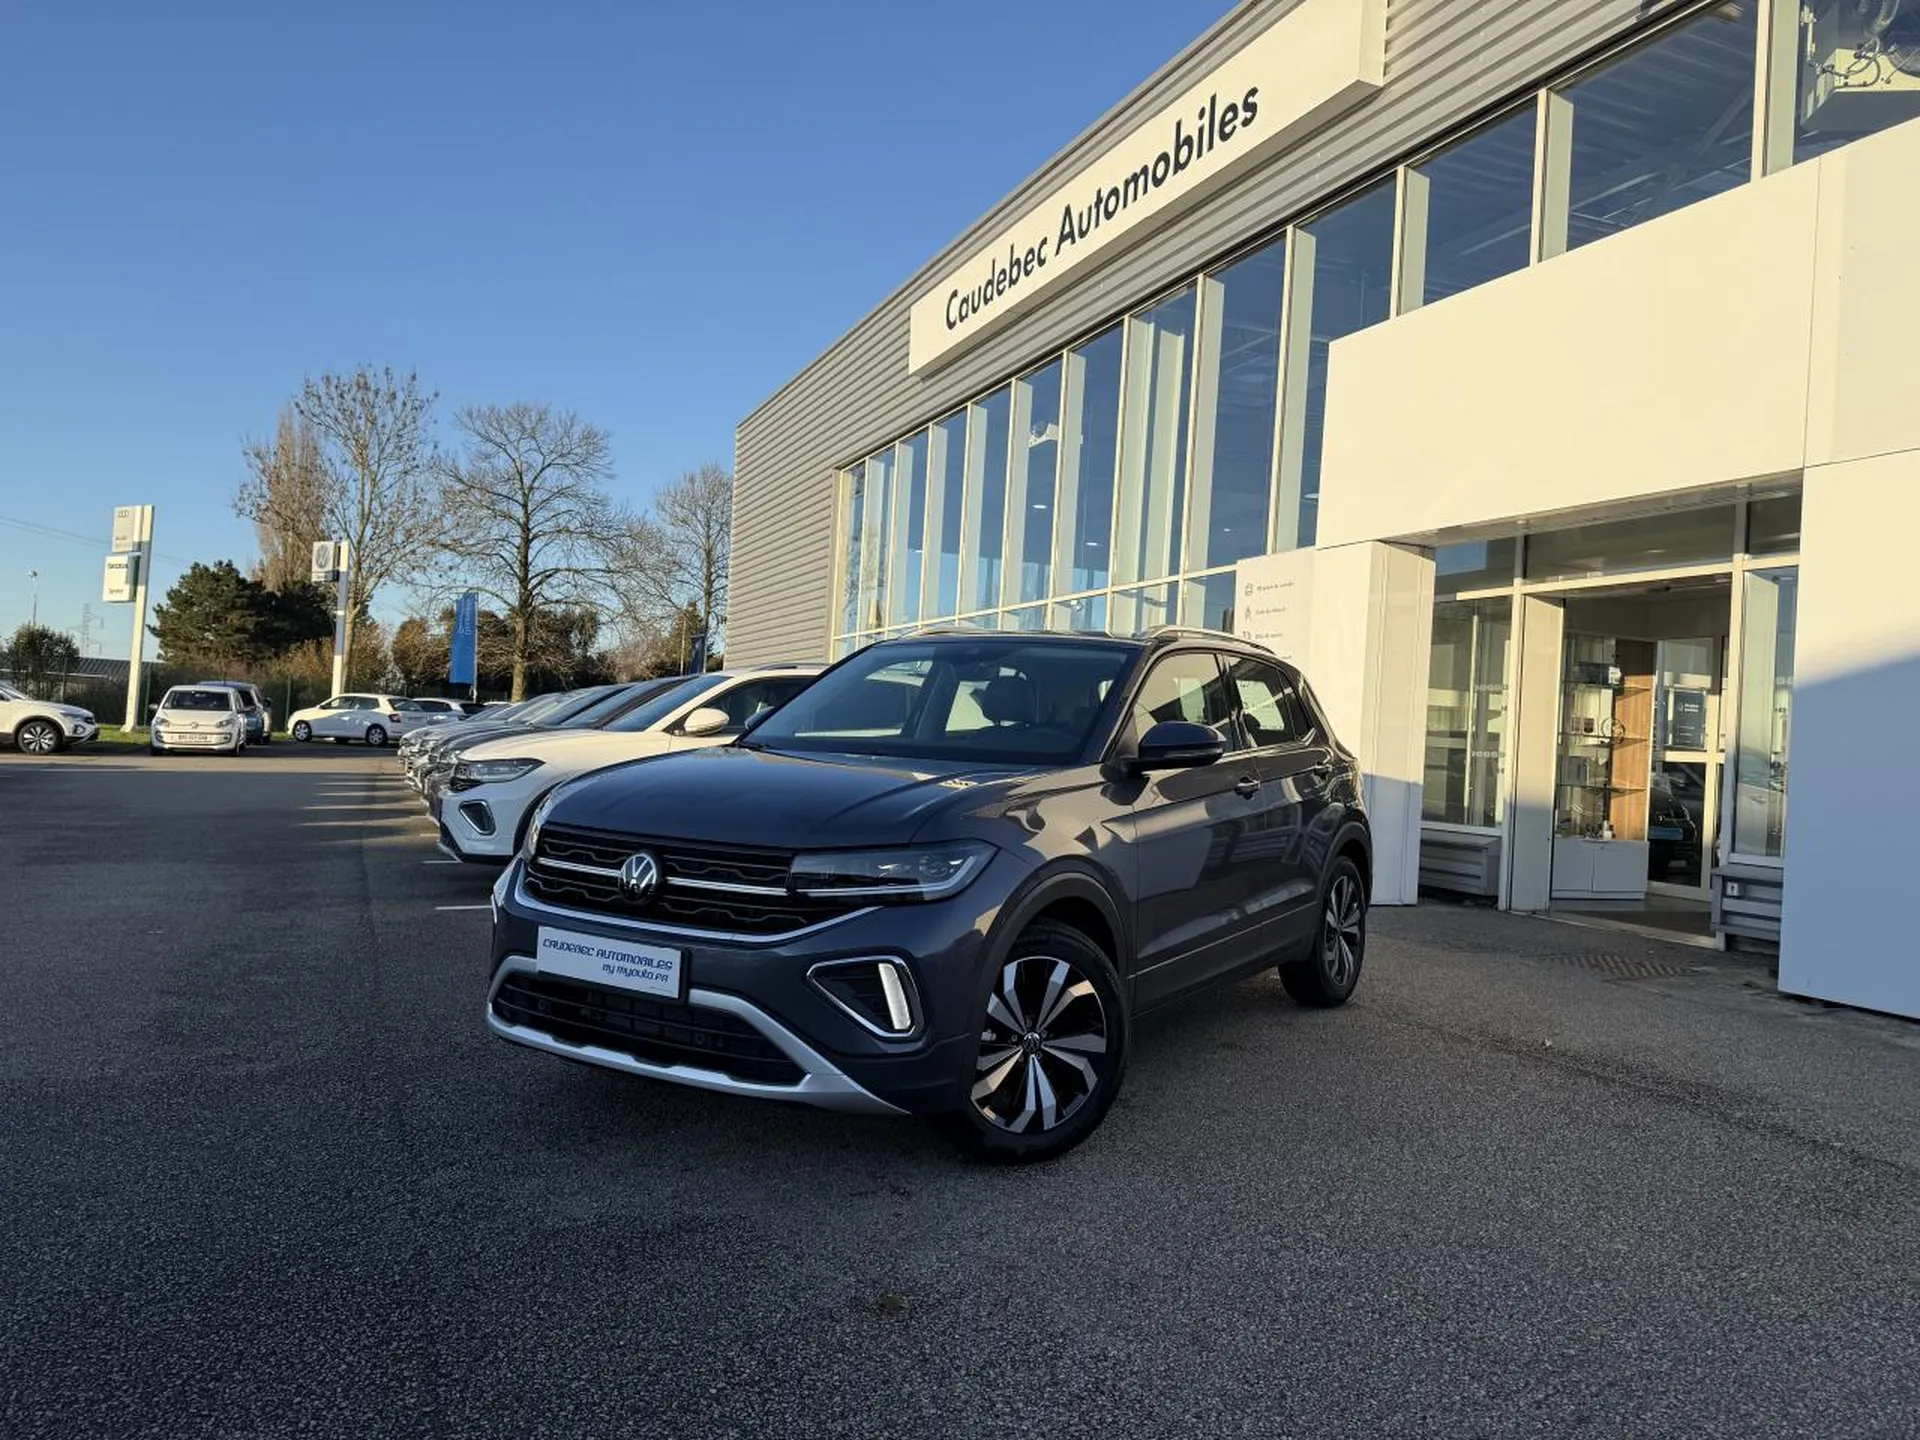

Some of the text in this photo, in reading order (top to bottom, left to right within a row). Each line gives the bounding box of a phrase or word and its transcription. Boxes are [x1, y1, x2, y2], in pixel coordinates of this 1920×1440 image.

[946, 86, 1259, 330] Caudebec Automobiles
[542, 938, 673, 972] CAUDEBEC AUTOMOBILES
